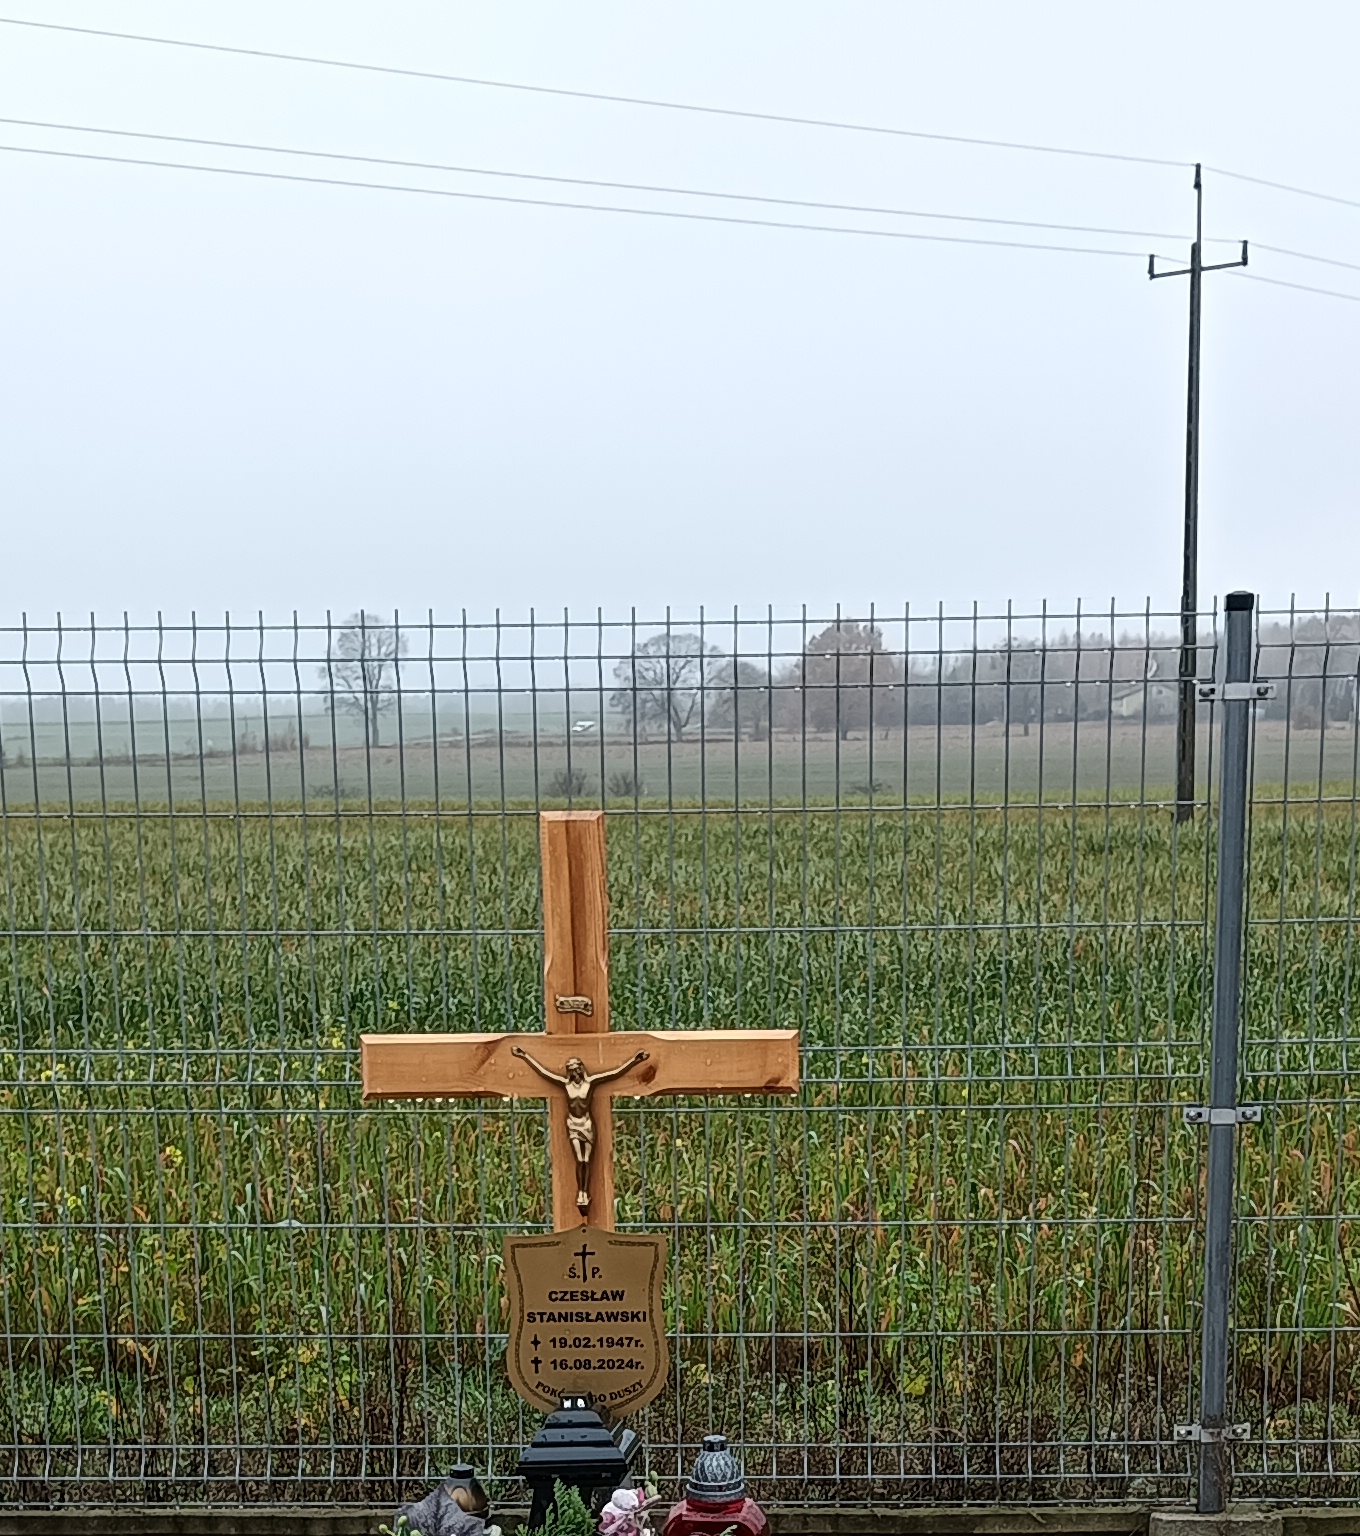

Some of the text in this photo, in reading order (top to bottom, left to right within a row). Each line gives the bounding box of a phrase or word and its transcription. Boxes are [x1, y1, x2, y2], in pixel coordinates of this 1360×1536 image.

[591, 1267, 603, 1279] P.
[548, 1290, 625, 1302] CZESŁAW
[526, 1311, 647, 1323] STANISŁAWSKI
[549, 1336, 644, 1348] 19.02.1947r.
[550, 1358, 645, 1370] 16.08.2024r.
[609, 1379, 644, 1401] DUSZY
